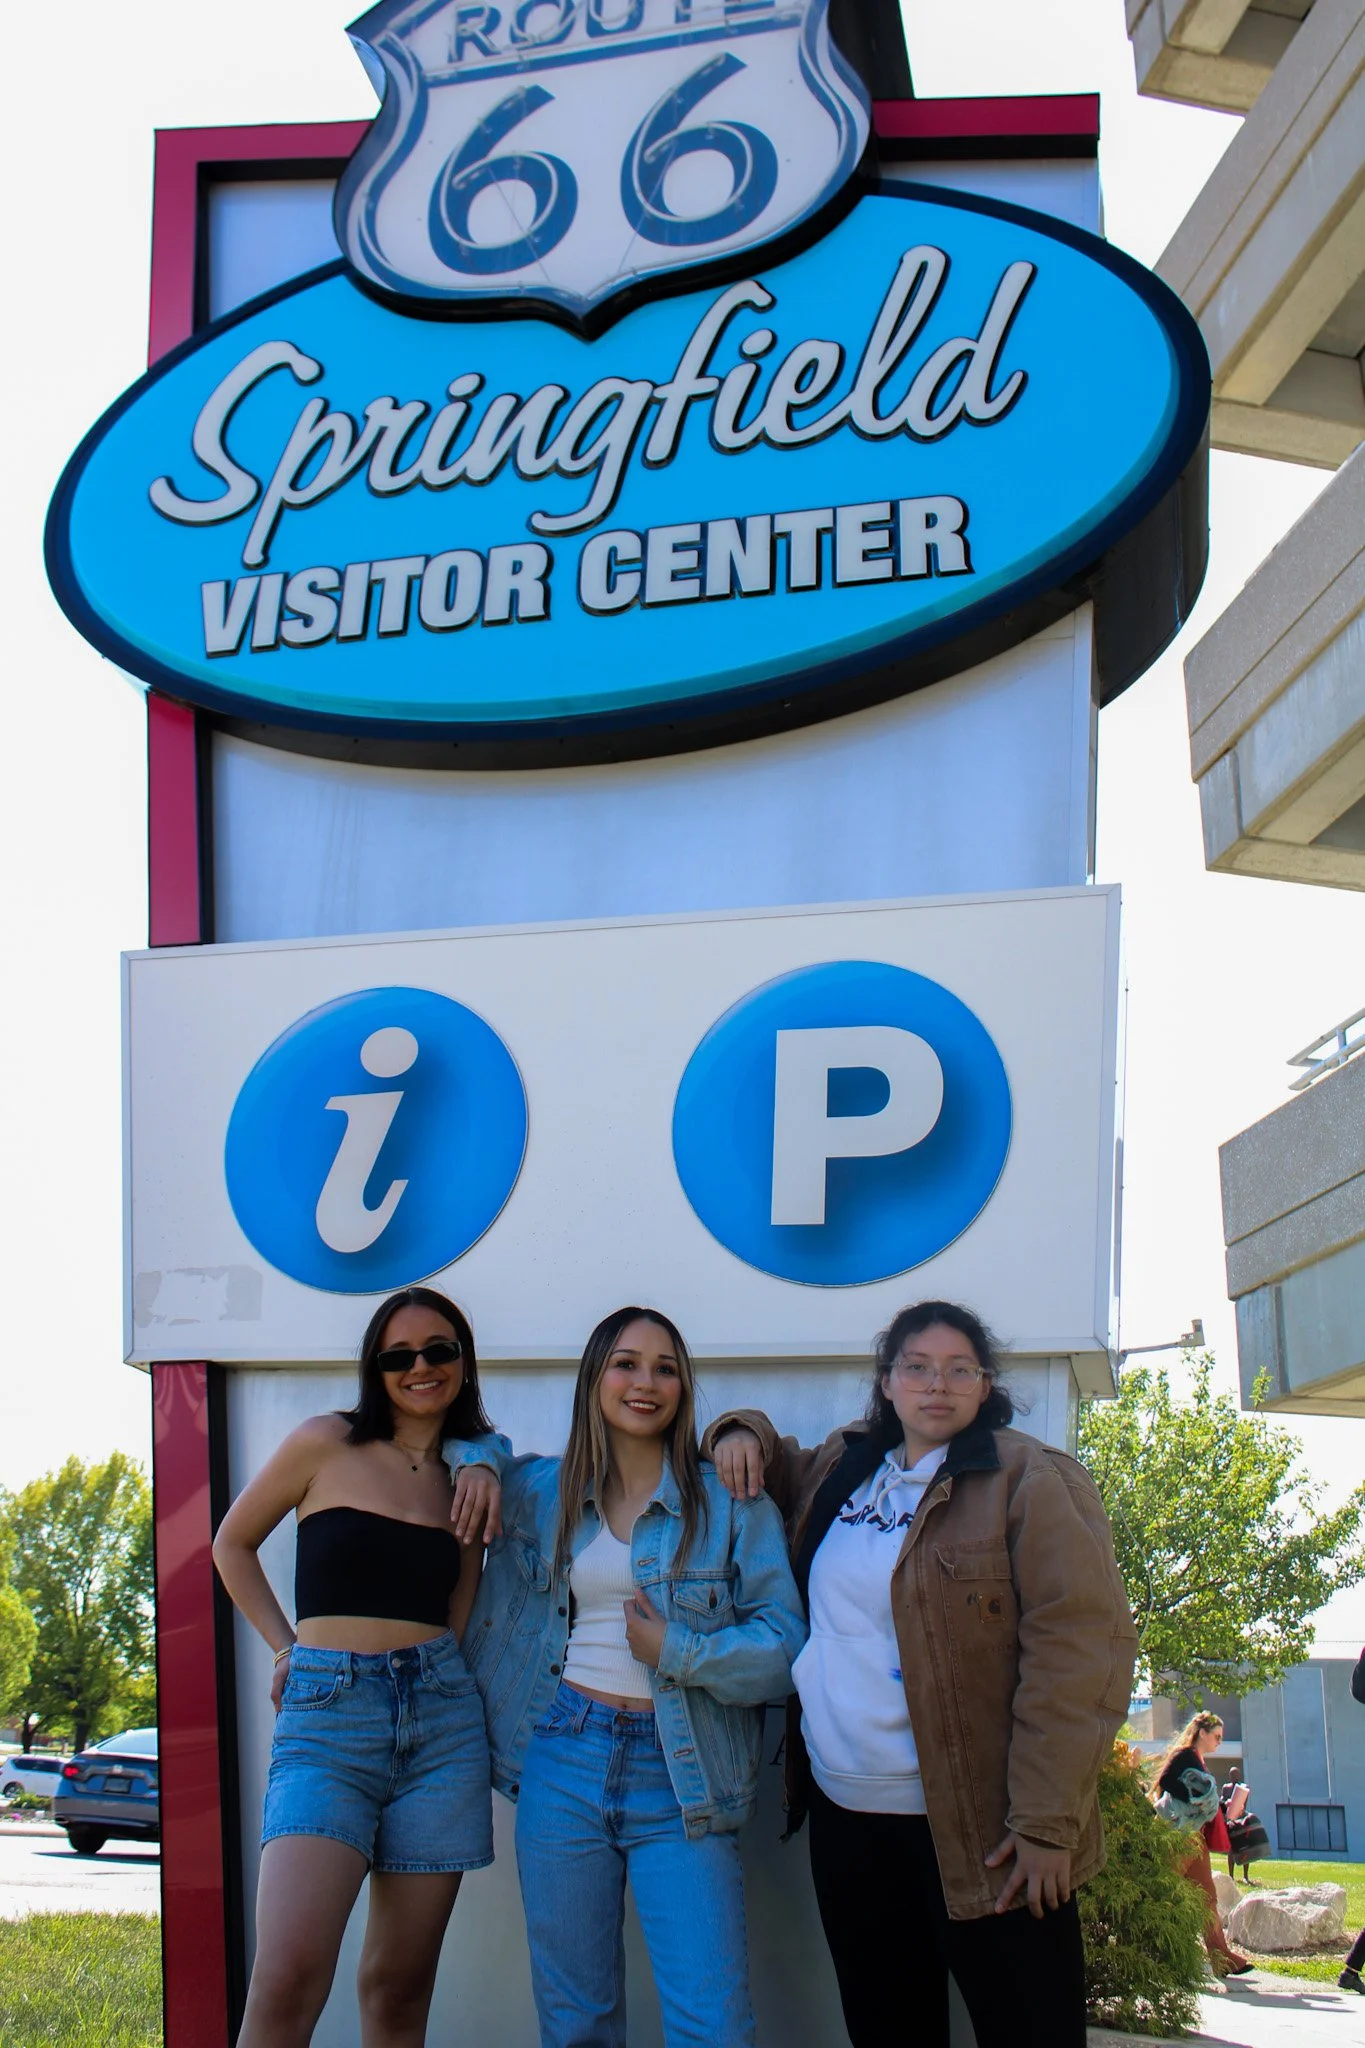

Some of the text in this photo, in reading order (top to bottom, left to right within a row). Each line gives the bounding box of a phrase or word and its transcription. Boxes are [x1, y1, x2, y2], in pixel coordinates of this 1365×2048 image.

[447, 0, 776, 61] ROU
[427, 52, 779, 276] 66
[149, 244, 1034, 567] Springfield
[202, 495, 969, 656] VISITOR CENTER
[770, 1025, 944, 1226] P
